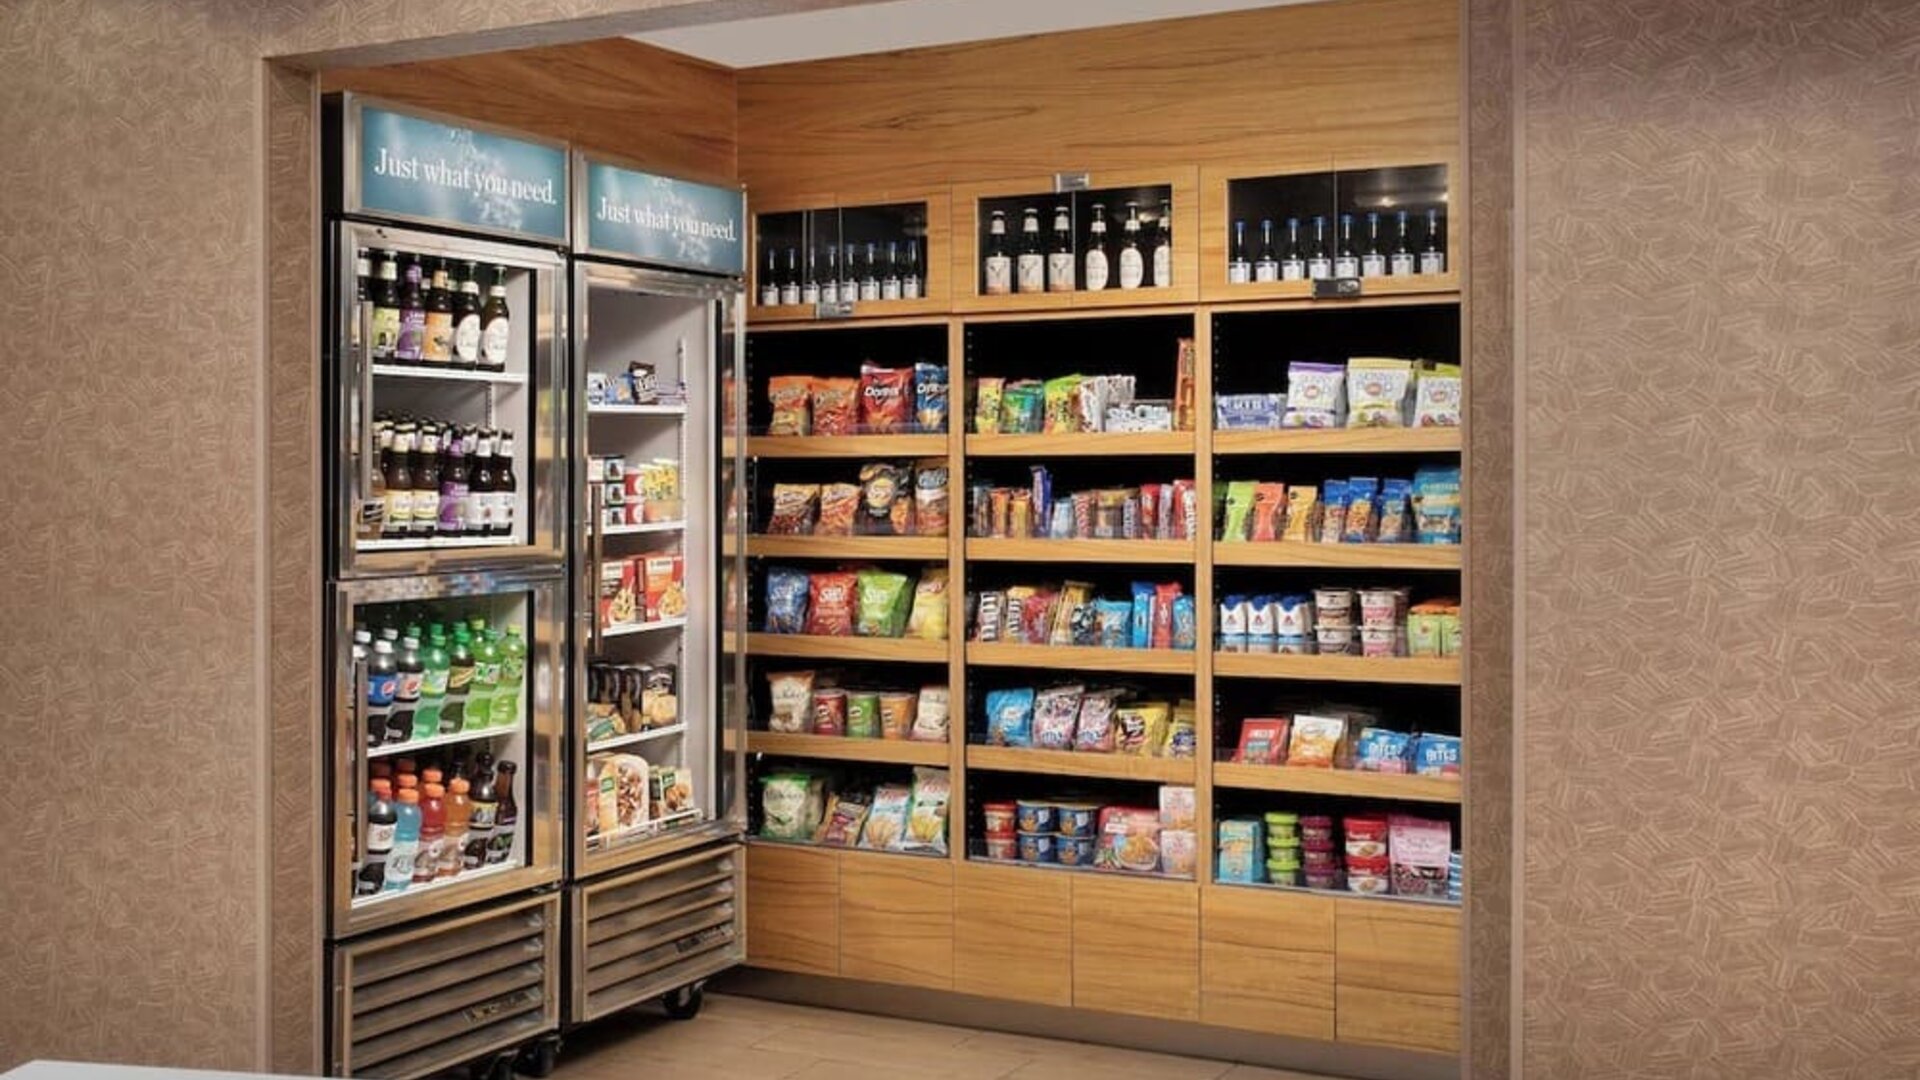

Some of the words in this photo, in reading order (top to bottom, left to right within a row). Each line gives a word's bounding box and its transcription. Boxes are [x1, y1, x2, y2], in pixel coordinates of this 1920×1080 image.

[374, 147, 418, 181] Just
[423, 158, 471, 189] what
[473, 171, 509, 197] you
[510, 179, 557, 205] need.
[597, 196, 631, 224] Just
[634, 205, 670, 231] what
[671, 216, 700, 238] you
[701, 219, 738, 242] need.
